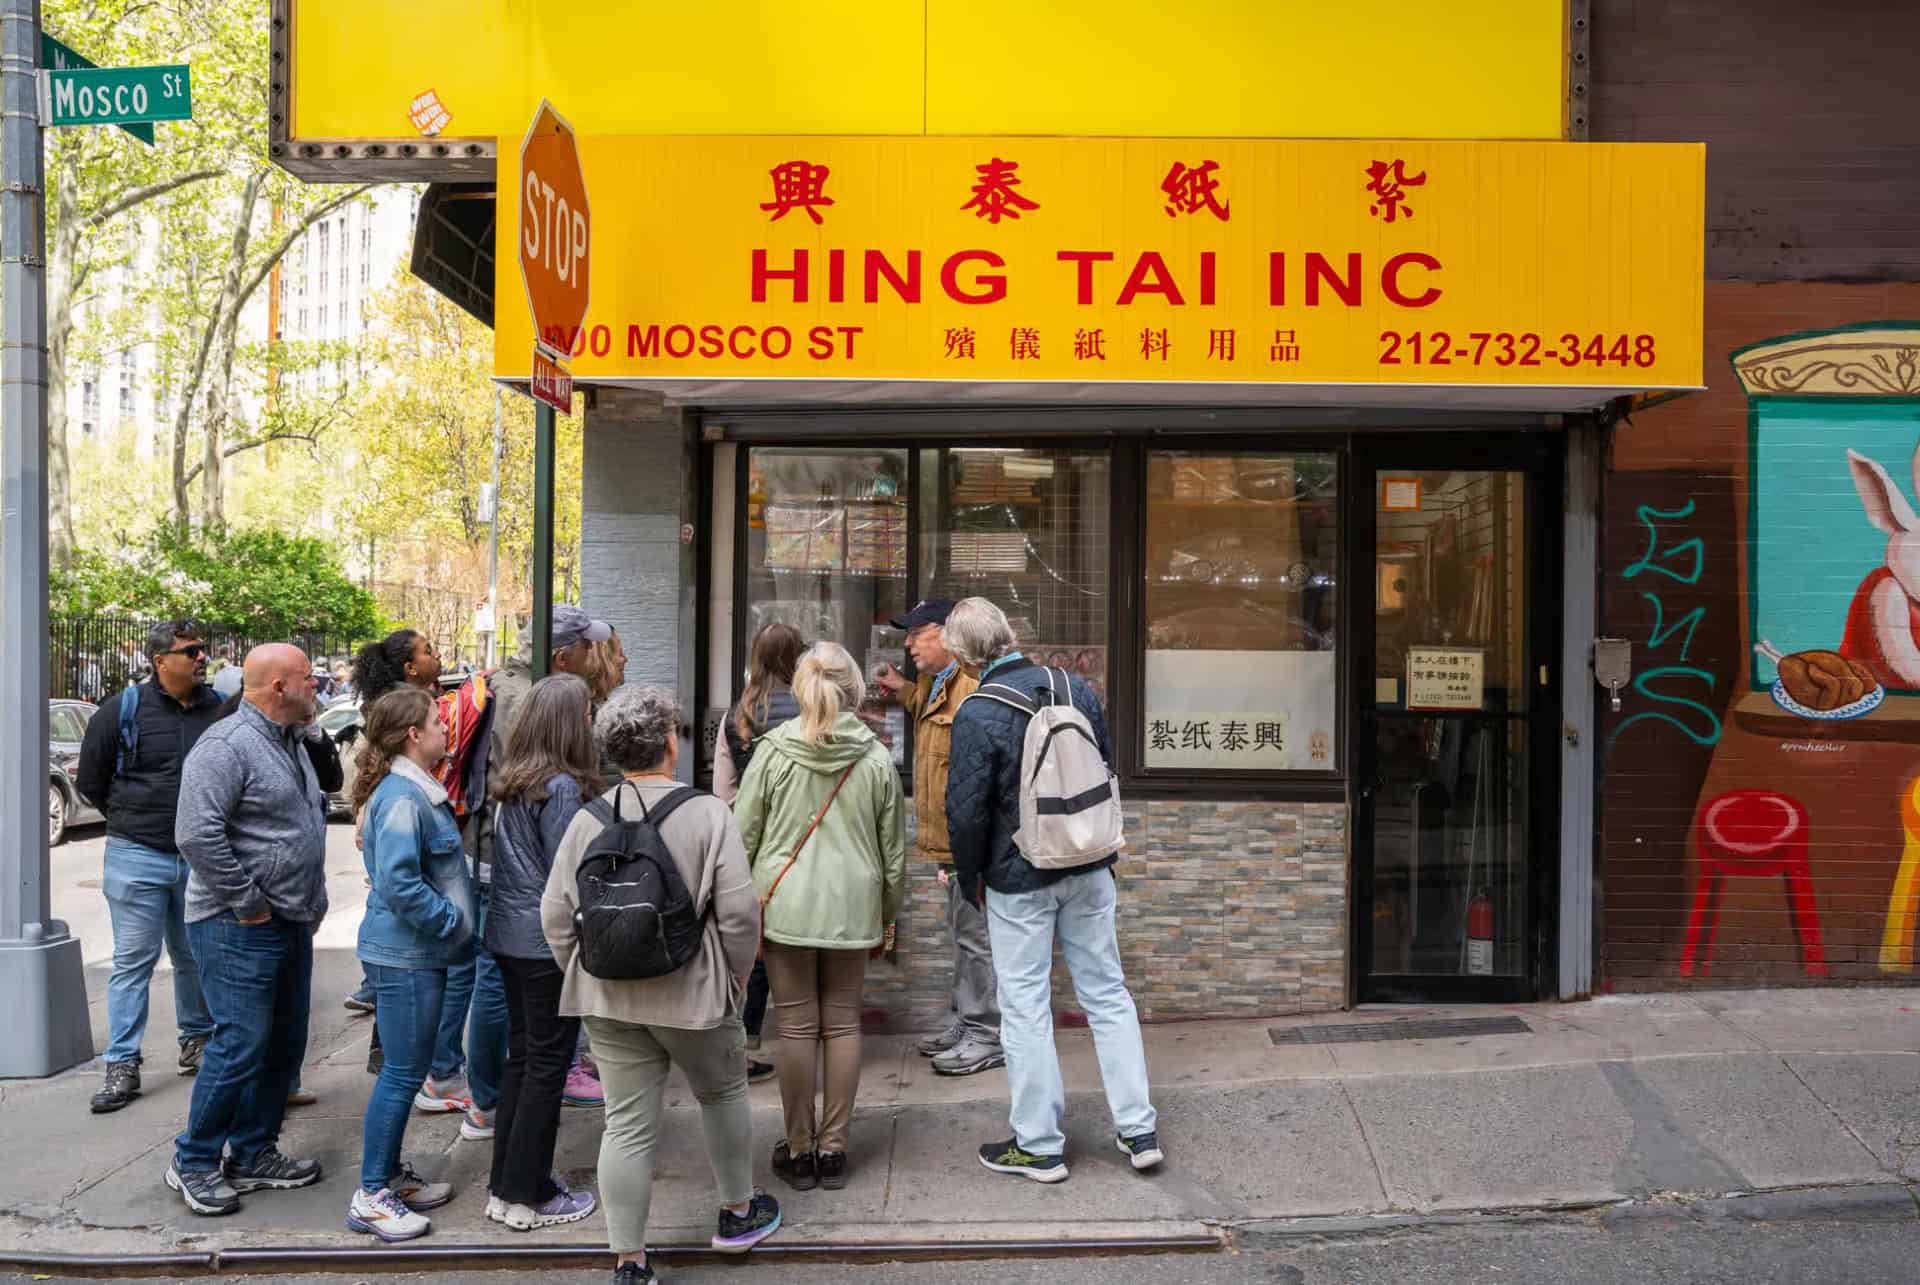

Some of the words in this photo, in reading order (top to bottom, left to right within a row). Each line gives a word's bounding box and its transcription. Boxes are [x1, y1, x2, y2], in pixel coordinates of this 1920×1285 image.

[163, 73, 182, 98] St
[524, 169, 587, 289] STOP
[751, 248, 1007, 305] HING
[1056, 250, 1216, 306] TAI
[1269, 251, 1443, 308] INC
[627, 324, 792, 360] MOSCO
[807, 326, 864, 360] ST
[1379, 330, 1656, 369] 212-732-3448
[535, 360, 552, 393] ALL
